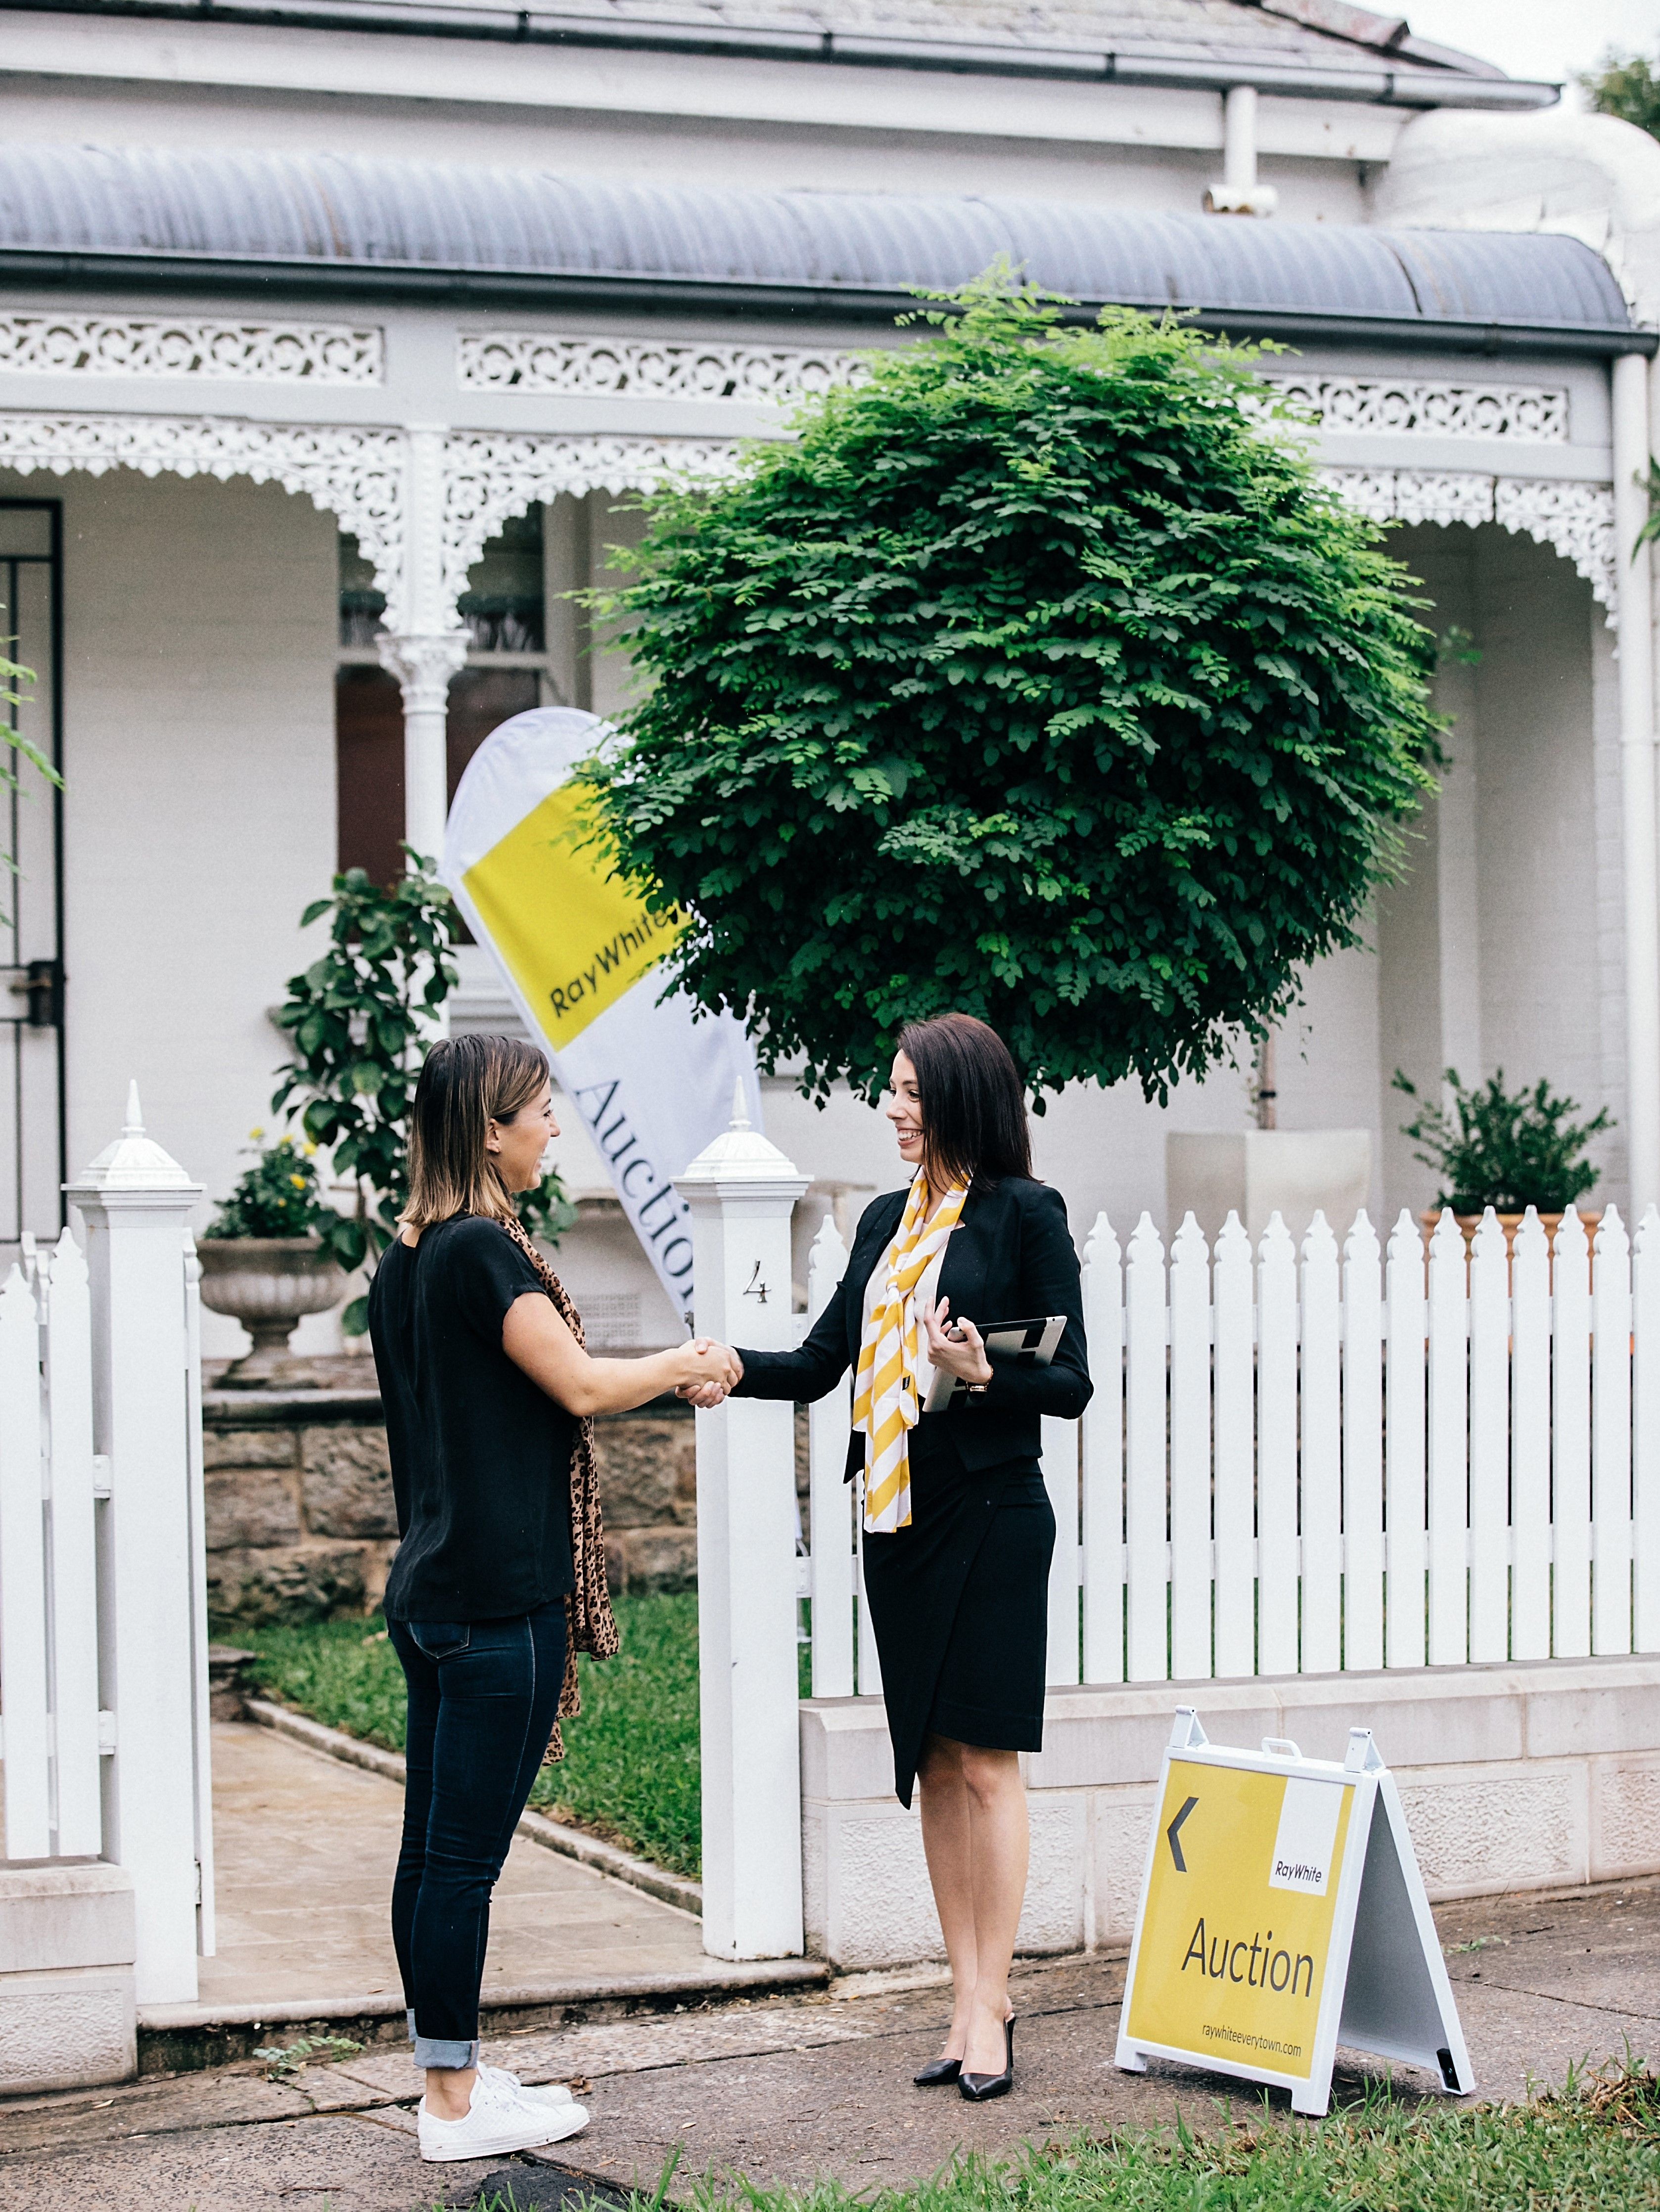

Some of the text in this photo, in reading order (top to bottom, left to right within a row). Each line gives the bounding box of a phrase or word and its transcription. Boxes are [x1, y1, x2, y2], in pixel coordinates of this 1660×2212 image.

[574, 1080, 693, 1299] Auctio
[742, 1259, 772, 1303] 4
[1275, 1860, 1322, 1883] RayWhite
[1180, 1917, 1313, 1997] Auction
[1201, 2025, 1302, 2057] raywhiteeverytown.com
